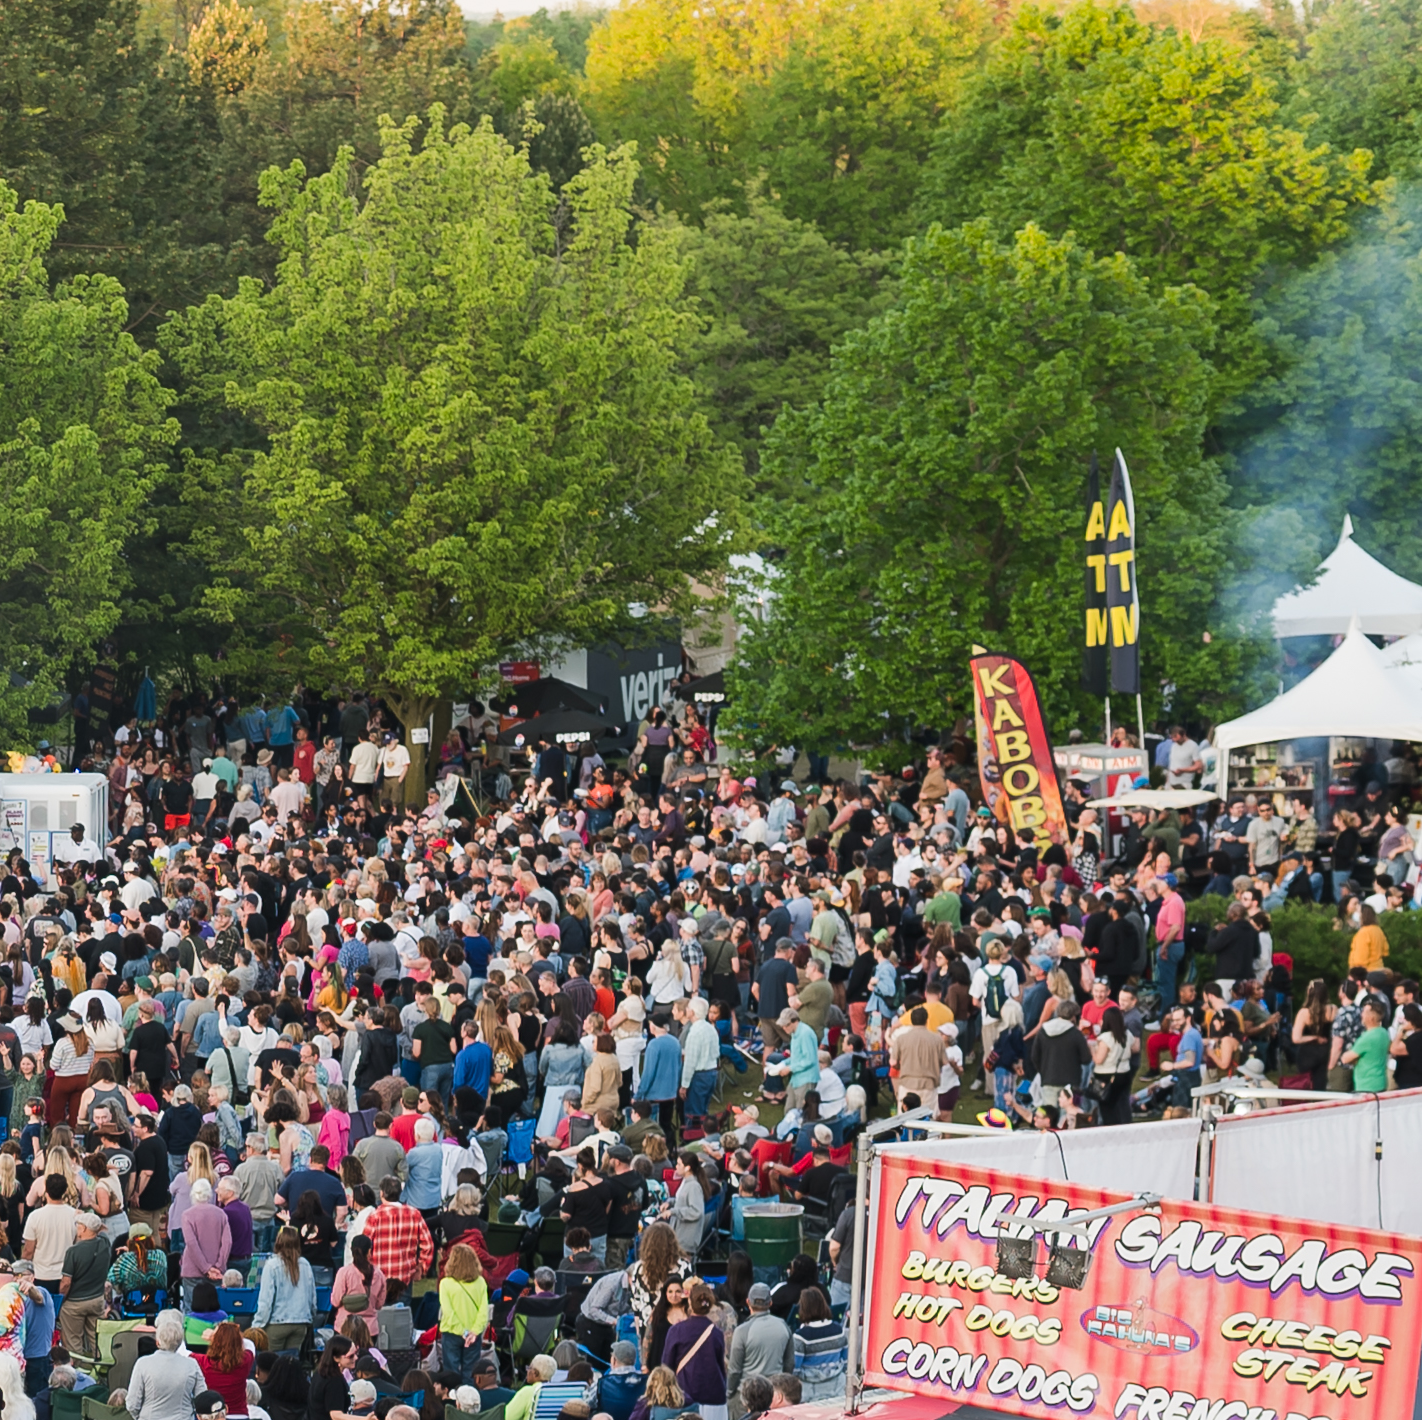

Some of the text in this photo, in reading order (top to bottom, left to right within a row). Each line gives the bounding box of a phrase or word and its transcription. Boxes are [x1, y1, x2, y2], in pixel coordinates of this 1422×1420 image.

[621, 655, 682, 723] veriz
[556, 732, 590, 742] PEPSI
[901, 1251, 1060, 1305] BURGERS
[1115, 1215, 1414, 1301] SAUSAGE
[892, 1291, 1062, 1346] HOT DOGS
[1096, 1305, 1132, 1325] BIG
[1220, 1312, 1392, 1366] CHEESE
[882, 1337, 1098, 1413] CORN DOGS
[1233, 1347, 1374, 1398] STEAK
